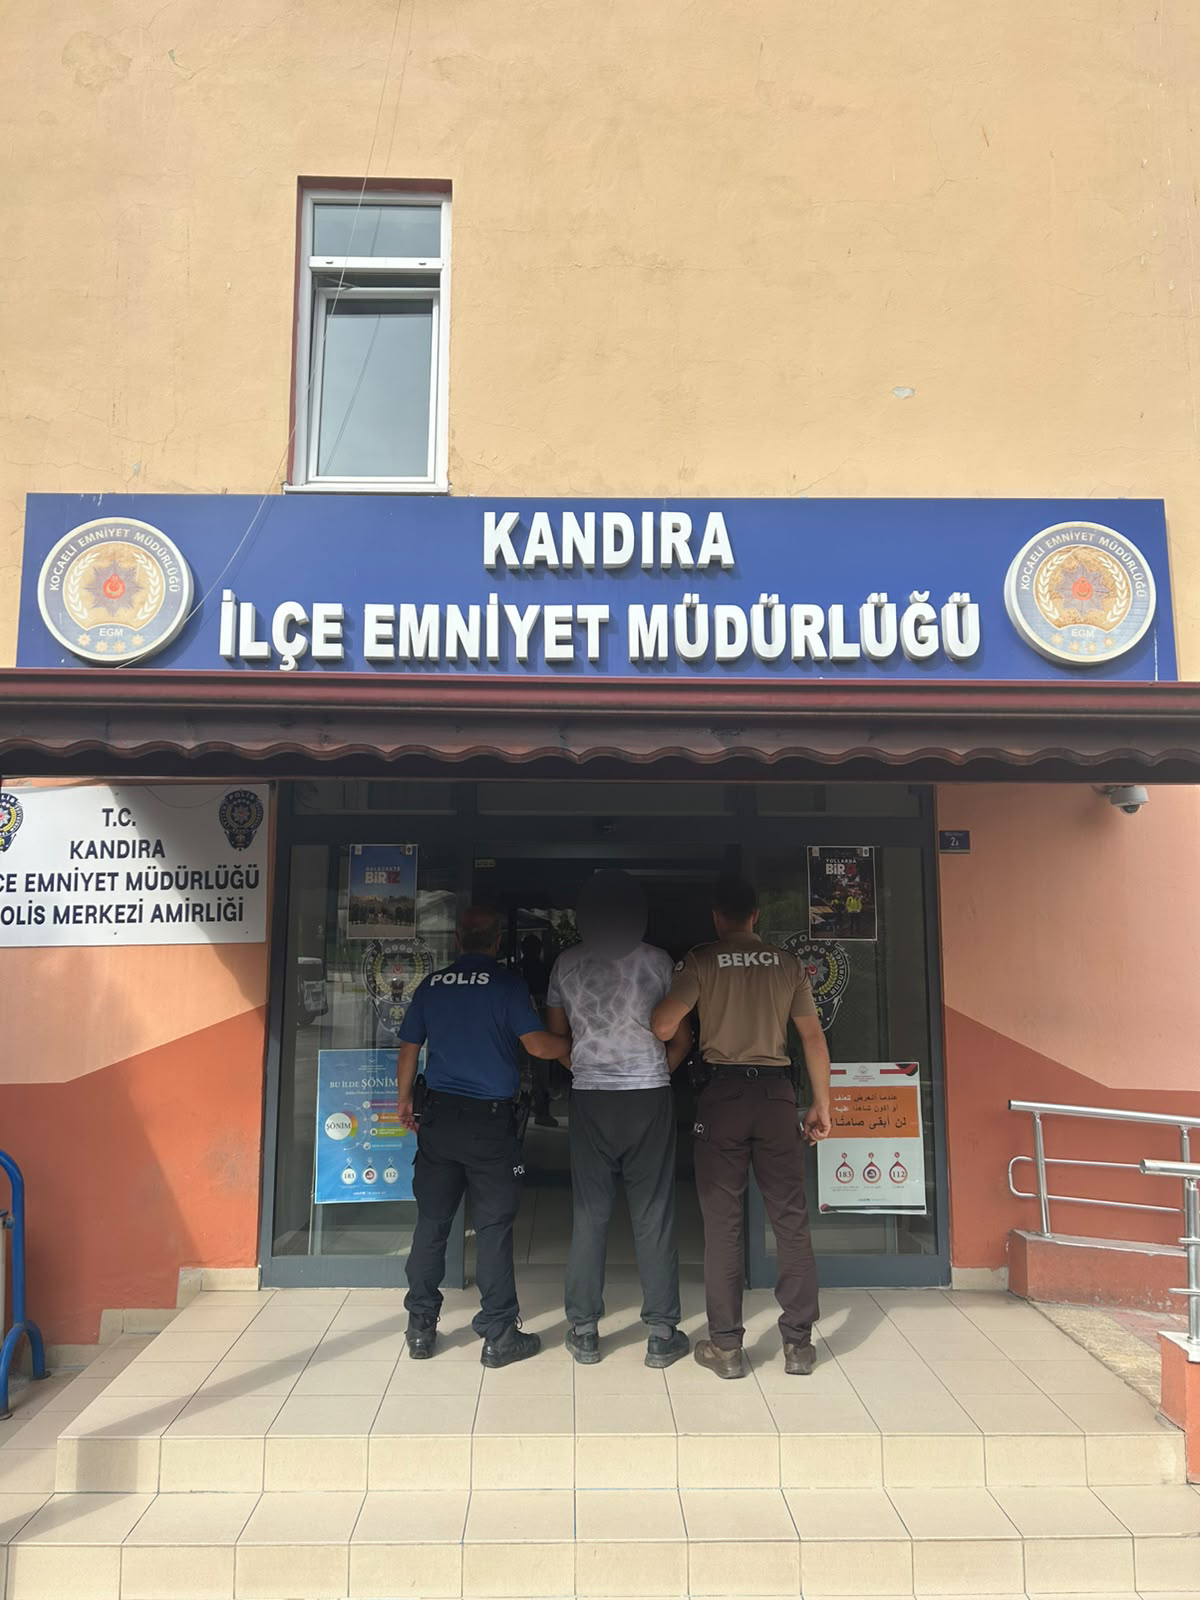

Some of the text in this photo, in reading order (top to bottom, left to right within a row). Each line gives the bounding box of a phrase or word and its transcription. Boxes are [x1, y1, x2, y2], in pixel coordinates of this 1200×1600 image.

[484, 511, 735, 570] KANDIRA
[50, 526, 181, 593] KOCAELİ EMNİYET MÜDÜRLÜĞÜ
[1021, 530, 1148, 598] KOCAELİ EMNİYET MÜDÜRLÜĞÜ
[99, 627, 124, 637] EGM
[219, 589, 980, 670] İLÇE EMNİYET MÜDÜRLÜĞÜ
[1071, 628, 1095, 638] EGM
[102, 808, 136, 827] T.C.
[69, 839, 166, 860] KANDIRA
[24, 867, 119, 893] EMNİYET
[125, 864, 260, 891] MÜDÜRLÜĞÜ
[0, 897, 244, 926] OLİS MERKEZİ AMİRLİĞİ
[717, 951, 779, 968] BEKÇİ
[361, 1076, 398, 1090] ŞÖNİM
